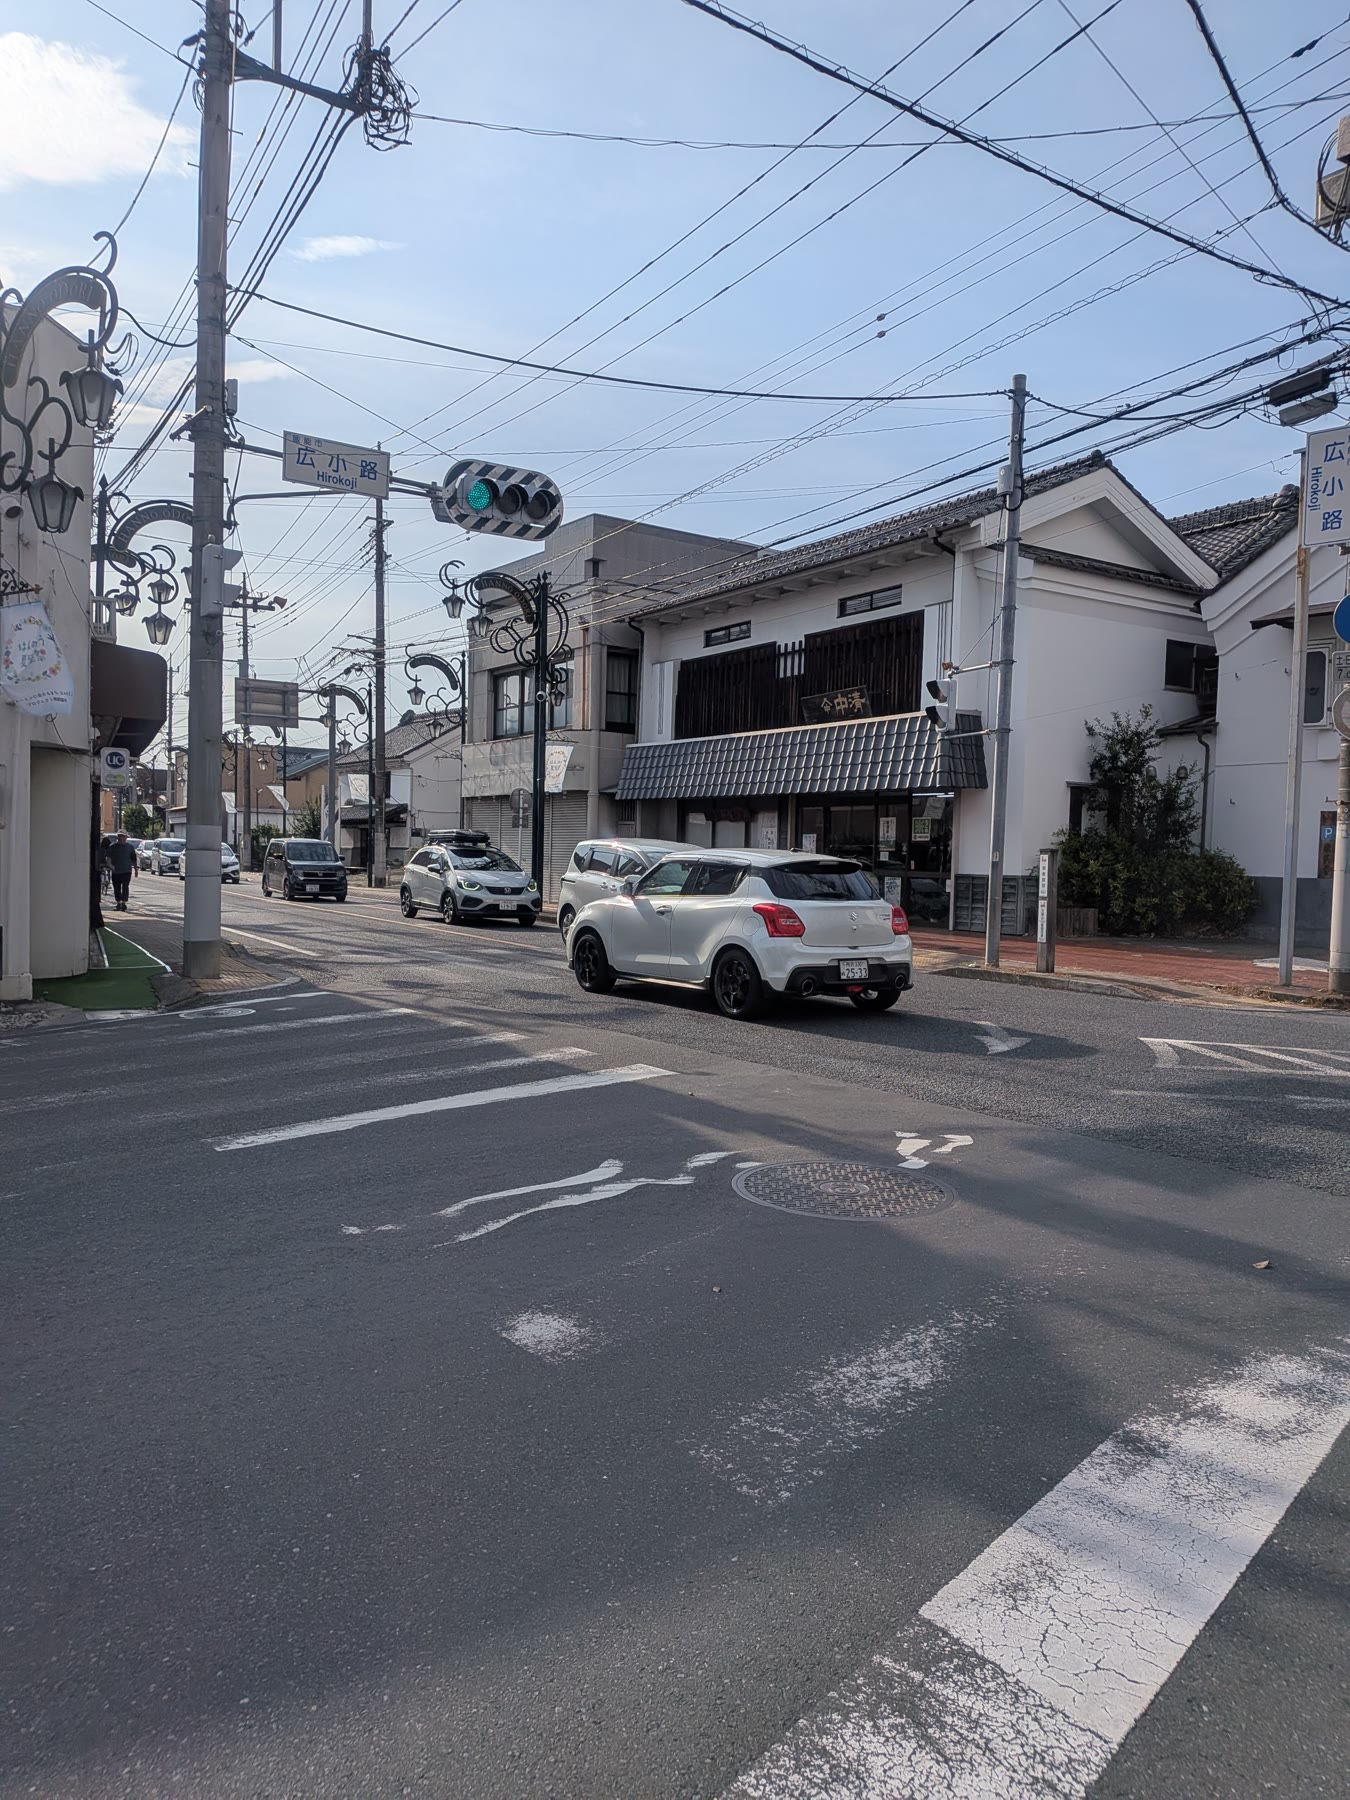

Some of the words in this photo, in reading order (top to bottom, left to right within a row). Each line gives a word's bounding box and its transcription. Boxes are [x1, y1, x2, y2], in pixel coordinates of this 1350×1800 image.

[296, 445, 378, 481] 広小路
[316, 470, 358, 489] Hirokoji
[1307, 466, 1323, 512] Hirokoji
[1321, 441, 1346, 532] 広小路
[481, 579, 513, 593] HANNO
[514, 591, 532, 619] ODORI
[845, 967, 868, 979] 25-33
